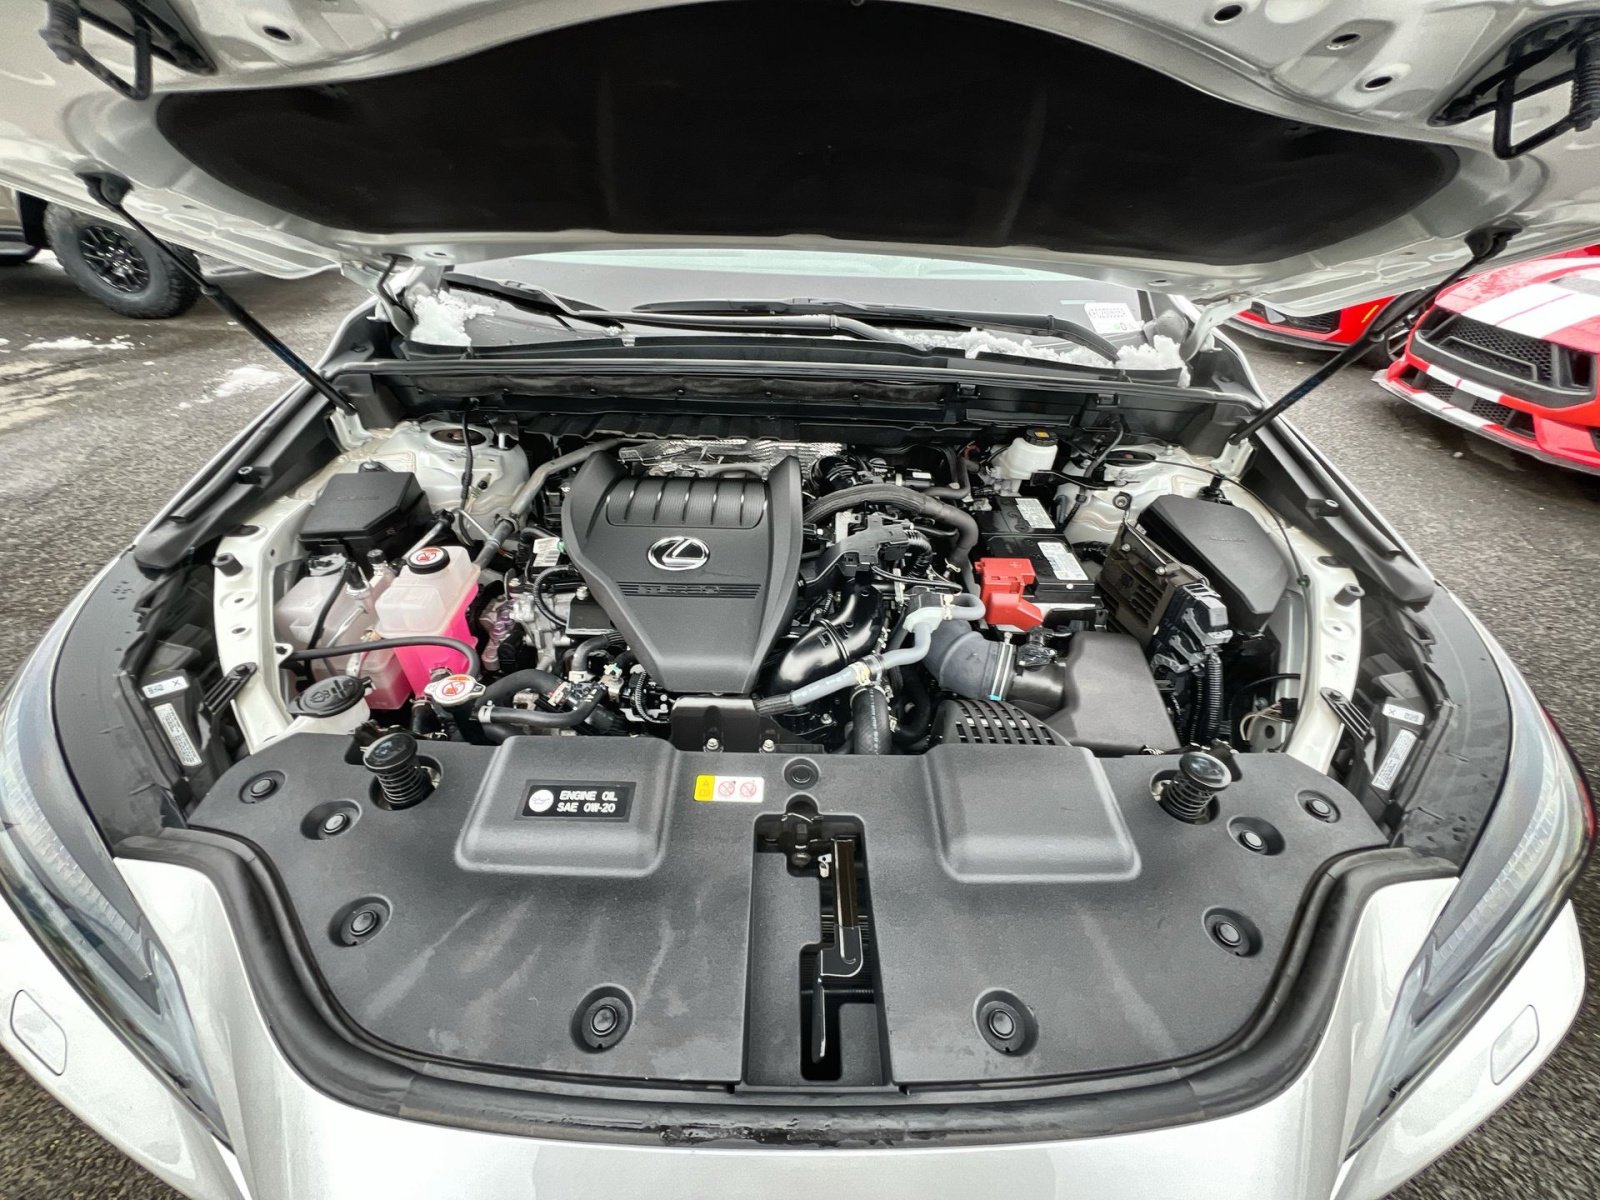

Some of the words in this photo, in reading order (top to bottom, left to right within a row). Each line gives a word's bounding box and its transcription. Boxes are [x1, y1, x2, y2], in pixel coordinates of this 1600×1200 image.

[559, 790, 597, 801] ENGINE
[601, 791, 618, 801] OIL
[556, 802, 579, 812] SAE
[583, 802, 616, 813] 0W-20
